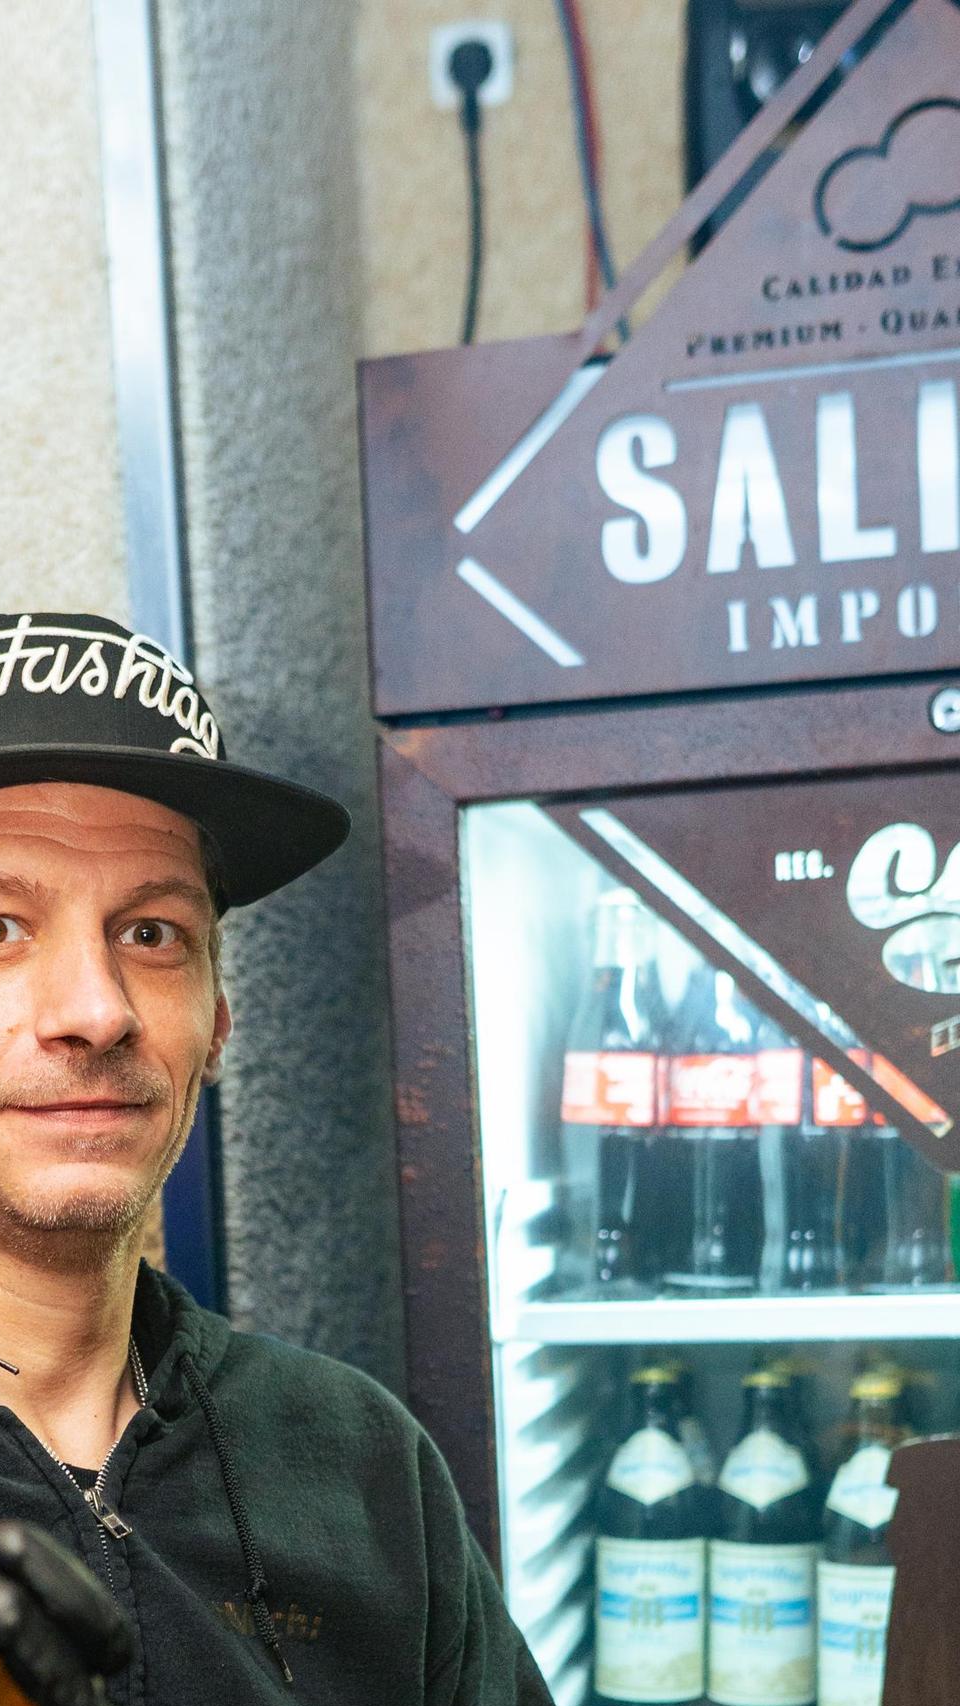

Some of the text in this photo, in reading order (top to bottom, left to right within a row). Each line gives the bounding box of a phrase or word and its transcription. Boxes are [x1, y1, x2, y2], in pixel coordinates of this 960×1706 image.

[762, 255, 960, 302] CALIDAD E
[686, 305, 960, 357] PREMIUM QUA
